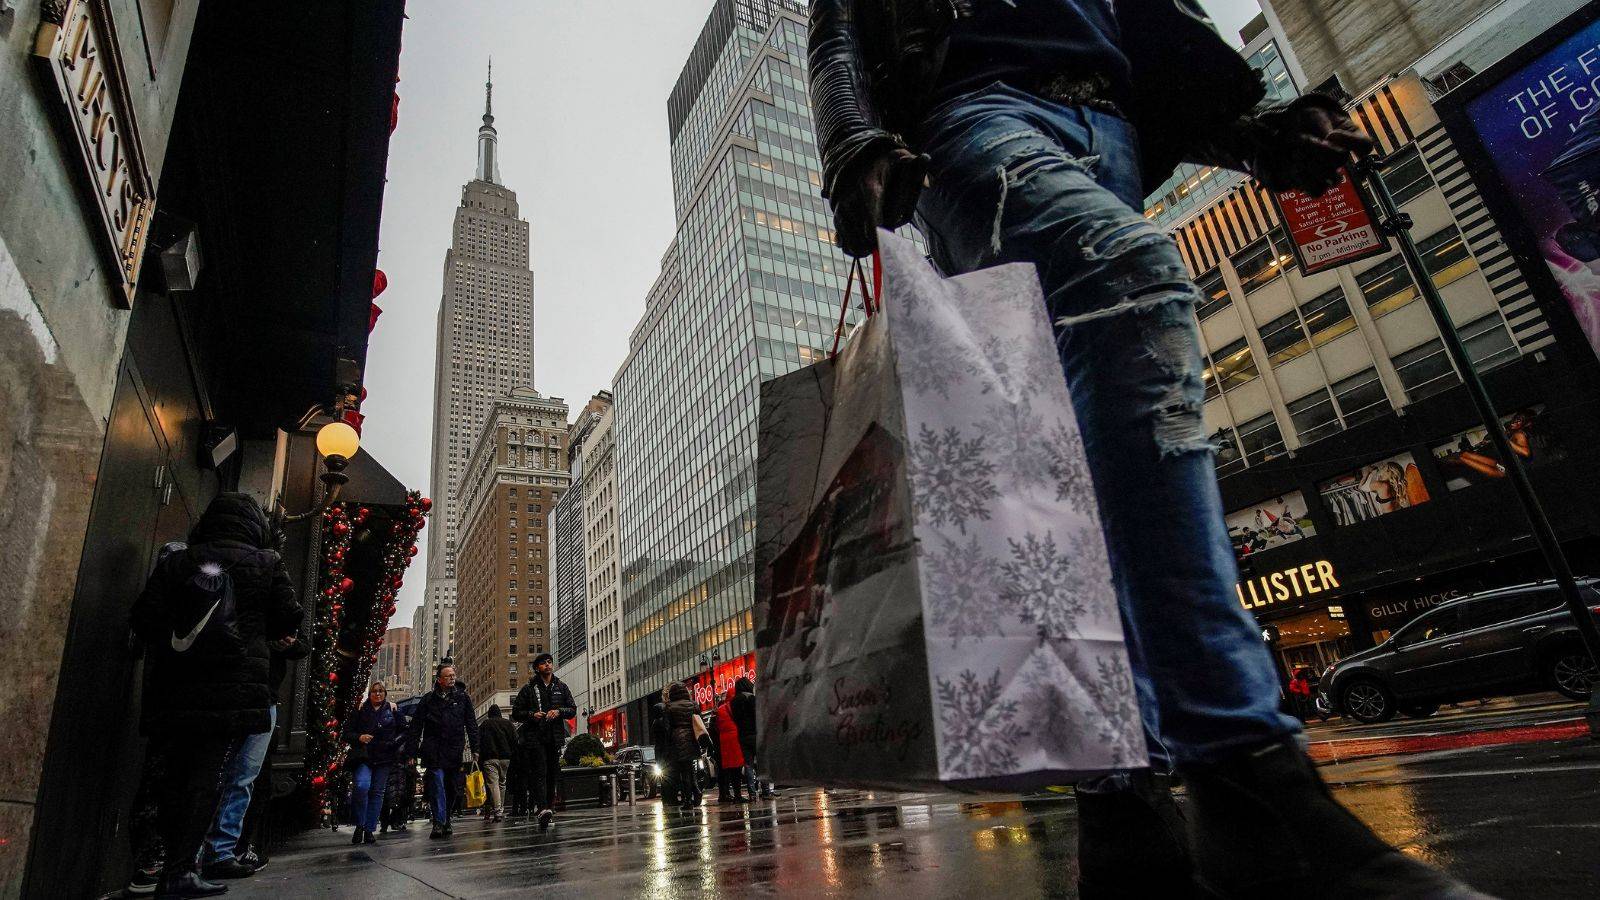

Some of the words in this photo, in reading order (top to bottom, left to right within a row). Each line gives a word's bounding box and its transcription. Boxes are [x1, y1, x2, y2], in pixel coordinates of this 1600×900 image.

[1508, 66, 1574, 113] THE
[1577, 44, 1600, 75] F
[1520, 102, 1558, 139] OF
[1280, 192, 1296, 202] No
[1327, 187, 1340, 196] pm
[1295, 202, 1320, 213] Monday
[1299, 217, 1326, 228] Saturday
[1331, 207, 1354, 218] Sunday
[1306, 210, 1319, 220] pm
[1334, 201, 1347, 210] pm
[1306, 244, 1323, 253] No
[1324, 230, 1369, 247] Parking
[1318, 252, 1331, 260] pm
[1336, 240, 1371, 254] Midnight
[1371, 600, 1408, 618] GILLY
[1413, 589, 1460, 610] HICKS
[694, 681, 719, 705] Foo
